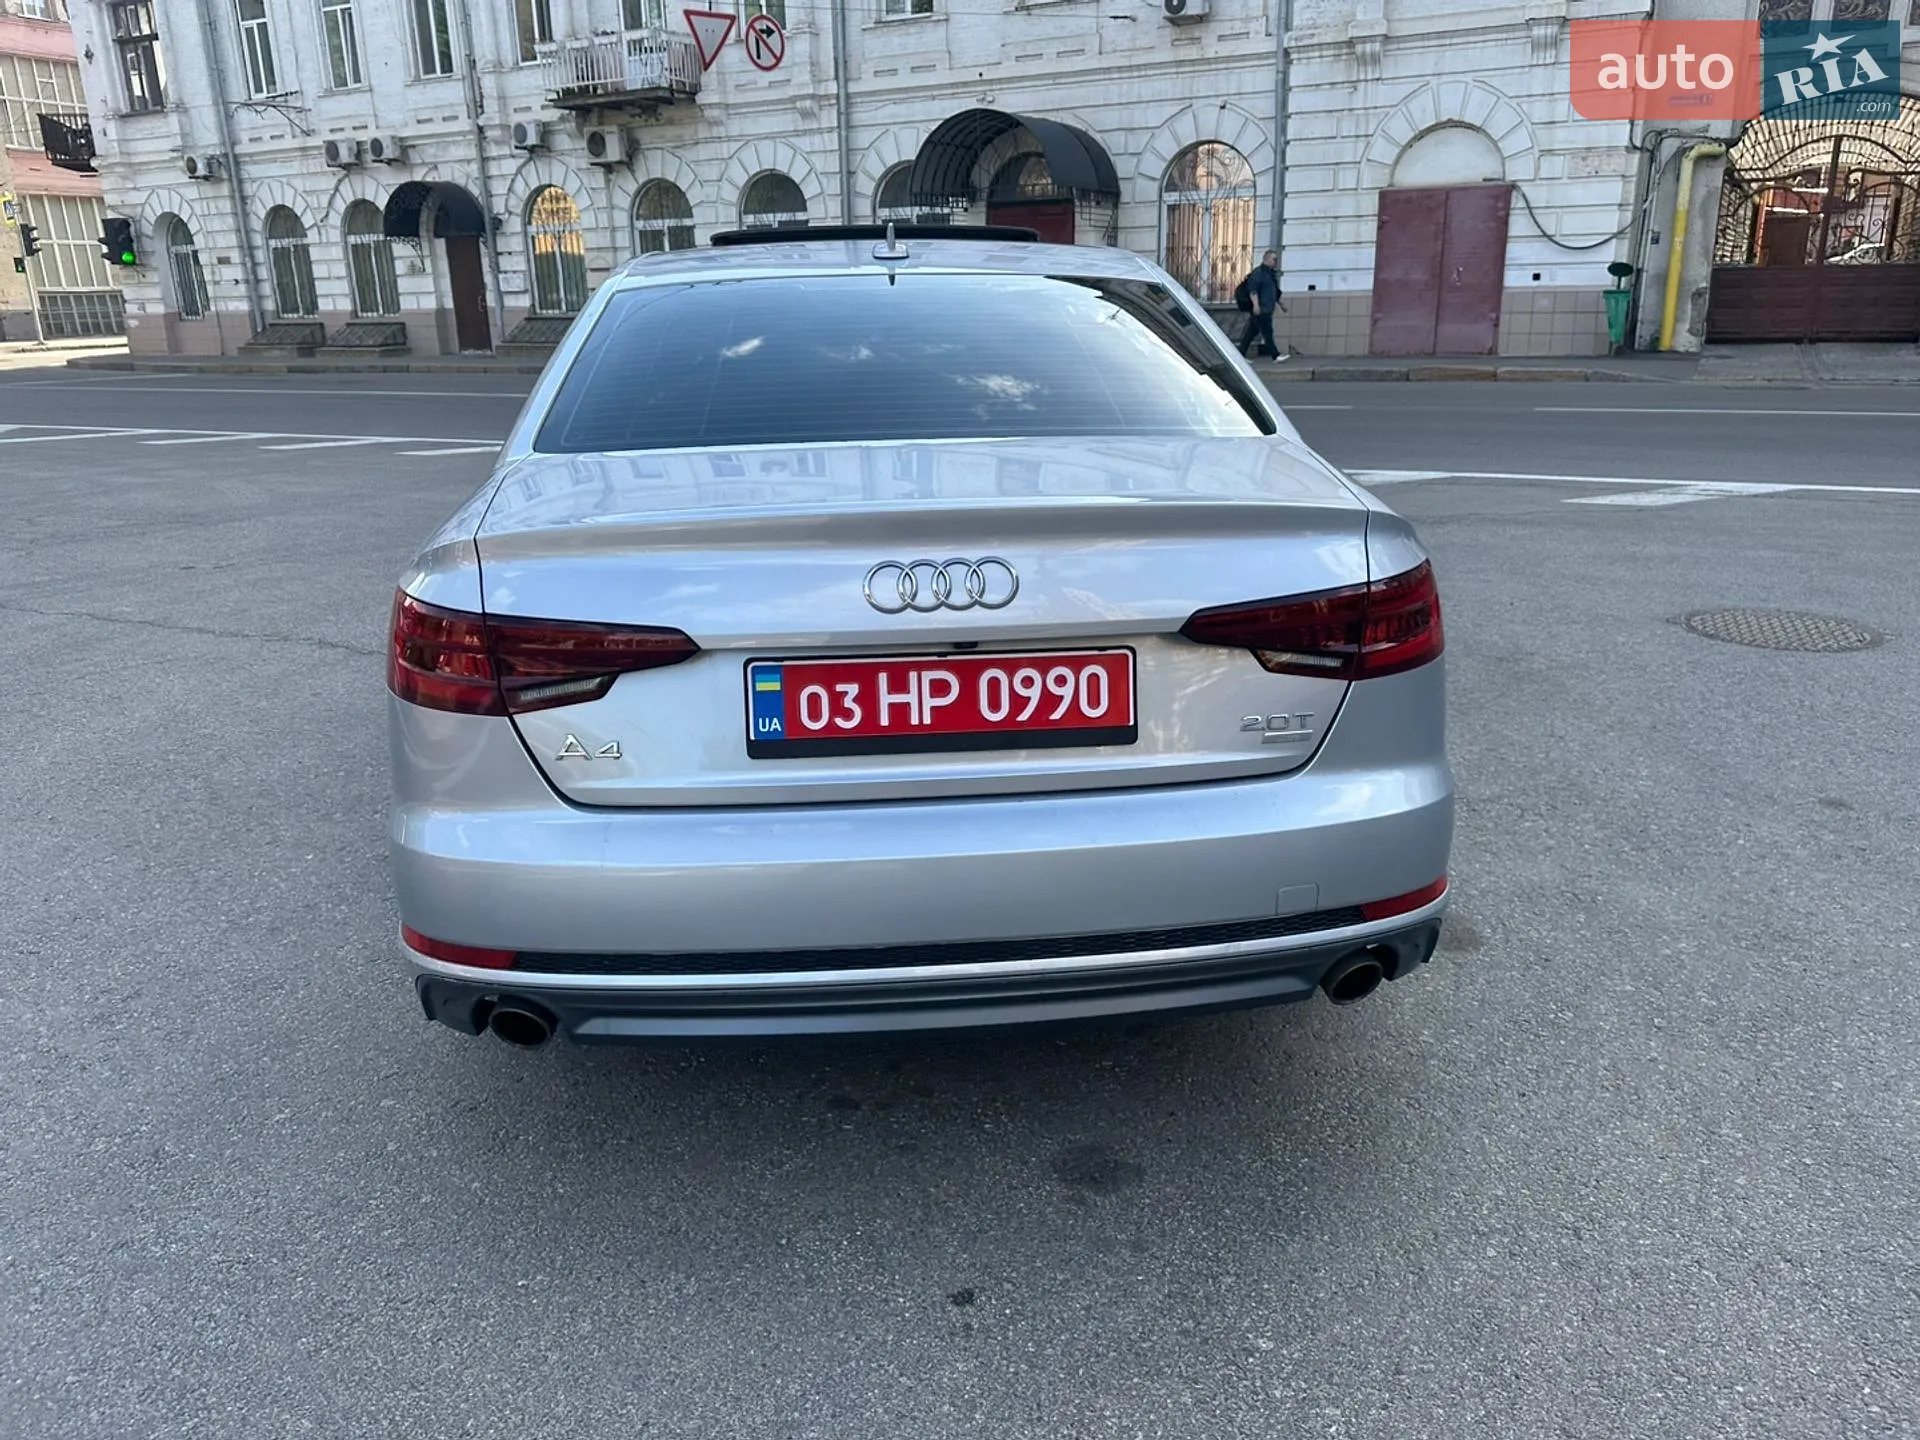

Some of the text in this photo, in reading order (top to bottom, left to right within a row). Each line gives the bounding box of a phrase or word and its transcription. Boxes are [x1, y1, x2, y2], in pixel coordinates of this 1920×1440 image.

[800, 664, 1108, 731] 03 HP 0990
[758, 717, 782, 732] UA
[554, 733, 622, 761] A4
